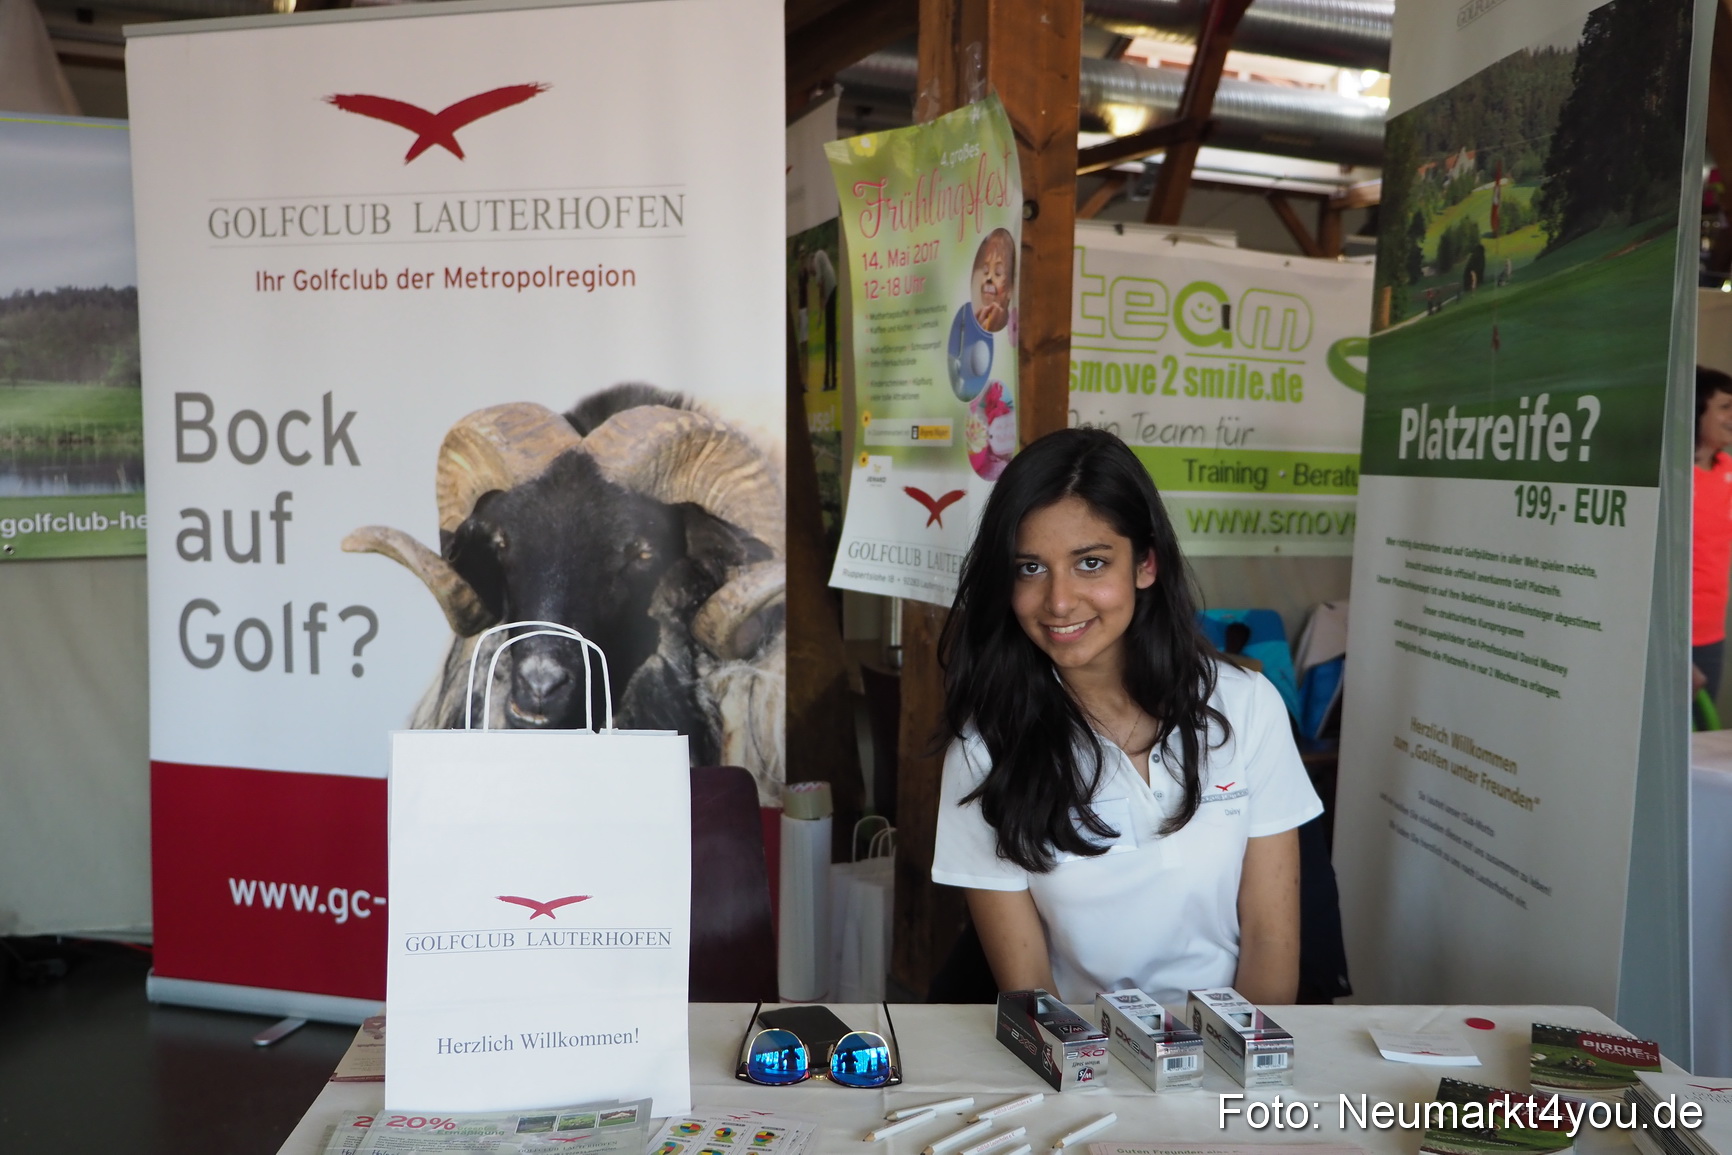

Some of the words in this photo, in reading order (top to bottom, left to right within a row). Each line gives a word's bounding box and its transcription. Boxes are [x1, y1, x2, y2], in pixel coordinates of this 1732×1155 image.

[853, 148, 1013, 242] Frühlingsfest
[208, 203, 392, 239] GOLFCLUB
[414, 195, 686, 233] LAUTERHOFEN
[862, 253, 883, 271] 14.
[887, 248, 910, 269] Mai
[914, 240, 940, 264] 2017
[256, 270, 285, 292] Ihr
[293, 268, 388, 291] Golfclub
[397, 267, 434, 289] der
[444, 264, 636, 293] Metropolregion
[864, 278, 901, 299] 12-18
[904, 276, 925, 295] Uhr
[175, 390, 362, 466] Bock
[1132, 412, 1206, 444] Team
[1215, 416, 1255, 455] für
[1399, 393, 1601, 462] Platzreife?
[1183, 459, 1269, 488] Training
[1186, 508, 1356, 534] www.smov
[1514, 485, 1566, 526] 199,-
[1574, 488, 1627, 527] EUR
[176, 490, 293, 564] auf
[848, 541, 921, 566] GOLFCLUB
[179, 598, 379, 678] Golf?
[1393, 735, 1409, 753] zum
[1450, 761, 1478, 785] unter
[1410, 716, 1449, 745] Herzlich
[1451, 731, 1518, 775] Willkommen
[405, 932, 515, 953] GOLFCLUB
[526, 931, 672, 948] LAUTERHOFEN
[437, 1036, 514, 1055] Herzlich
[520, 1028, 639, 1050] Willkommen!
[1596, 1047, 1658, 1061] MAKER
[386, 1116, 456, 1131] 20%
